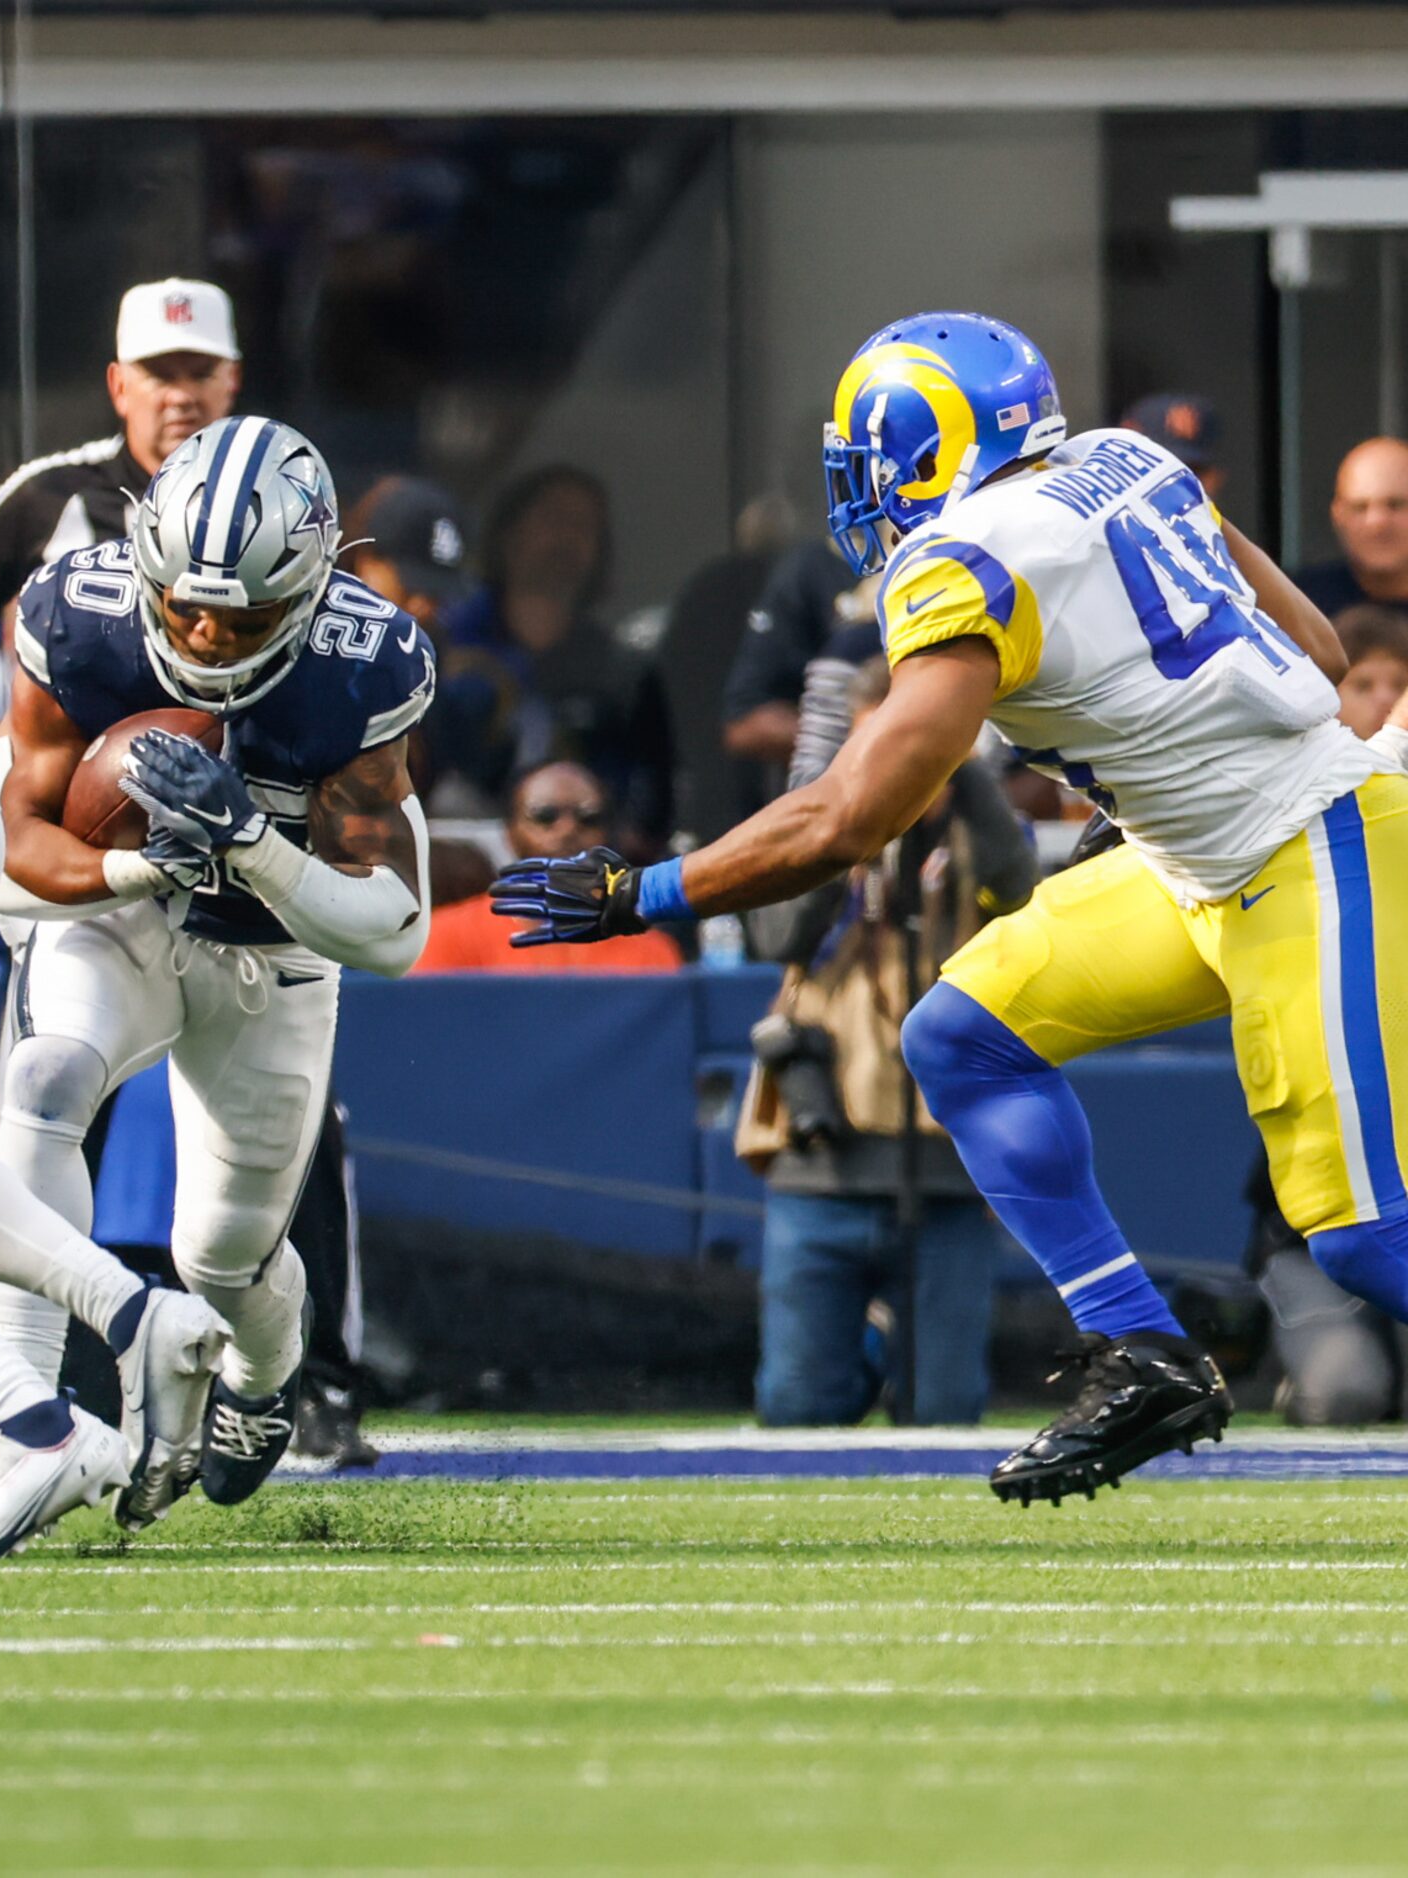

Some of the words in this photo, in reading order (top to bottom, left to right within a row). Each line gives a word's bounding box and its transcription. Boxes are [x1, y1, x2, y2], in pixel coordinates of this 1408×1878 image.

[1036, 439, 1163, 519] WAGNER
[64, 541, 139, 617] 20
[1104, 468, 1308, 680] 45
[309, 582, 398, 663] 20
